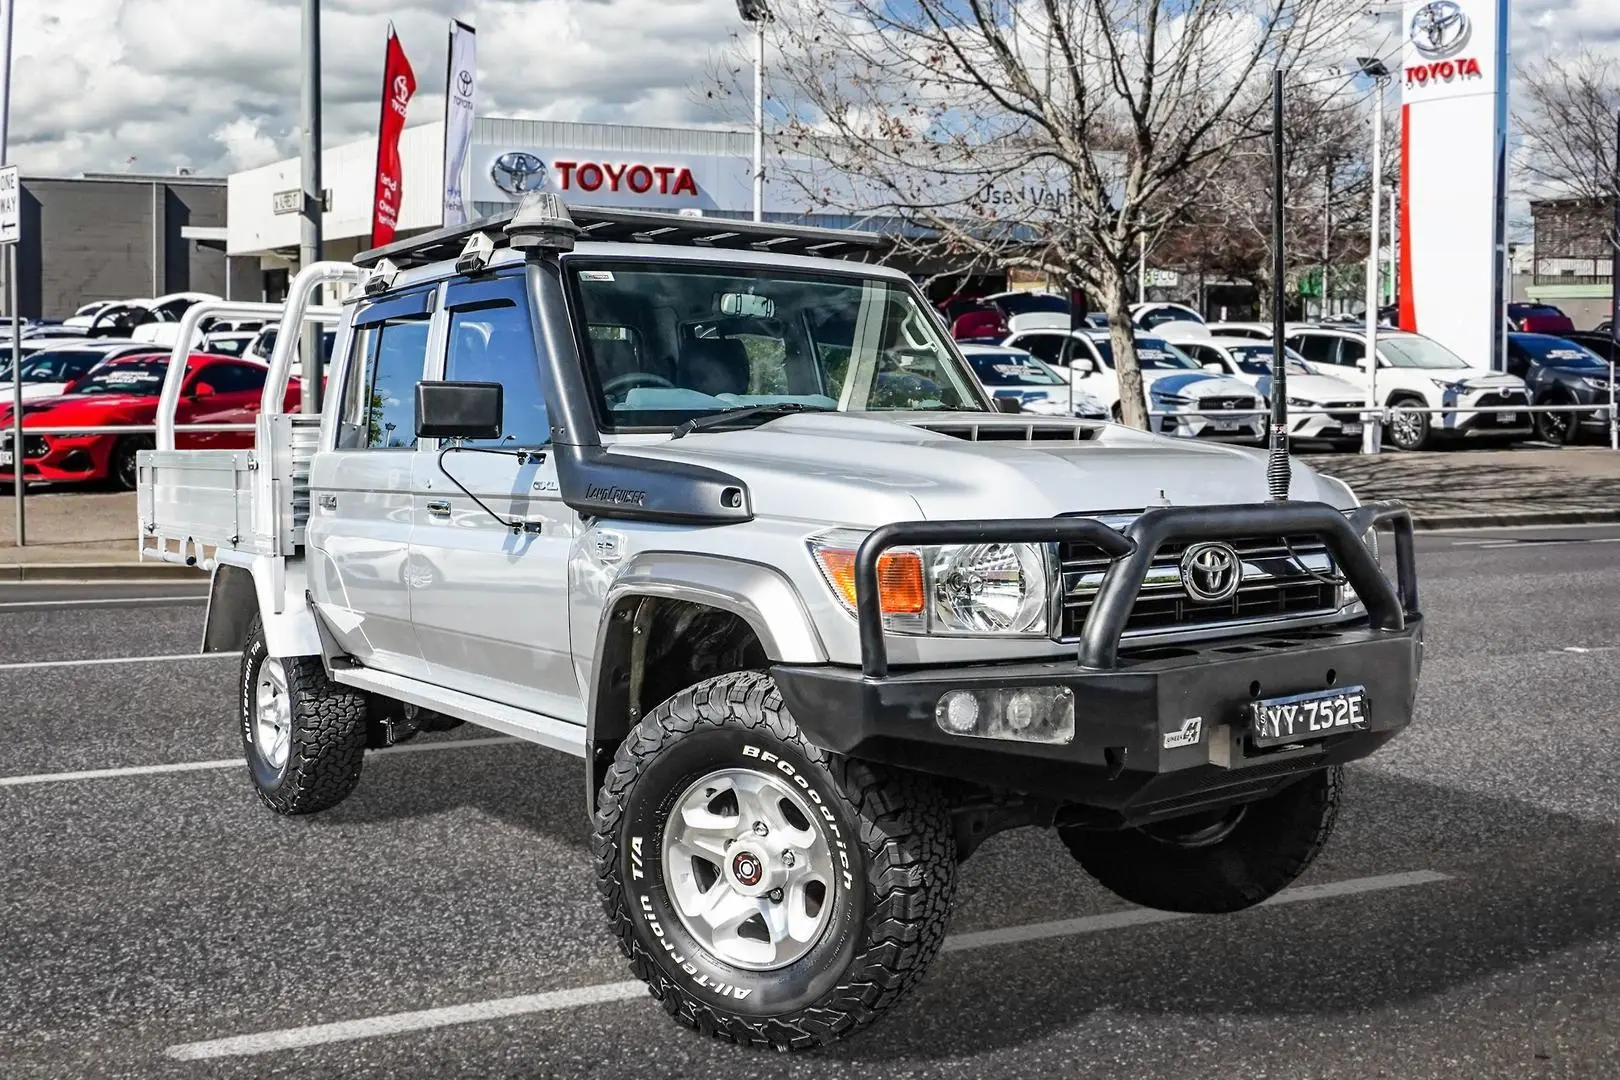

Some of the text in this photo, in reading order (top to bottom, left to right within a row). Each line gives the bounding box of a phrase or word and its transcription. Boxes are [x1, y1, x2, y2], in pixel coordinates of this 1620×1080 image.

[1405, 58, 1481, 83] TOYOTA
[0, 172, 15, 191] ONE
[554, 161, 698, 196] TOYOTA
[0, 196, 16, 214] WAY
[742, 744, 853, 890] BFGoodrich
[631, 836, 643, 881] T/A
[640, 895, 752, 1000] All-Terrain
